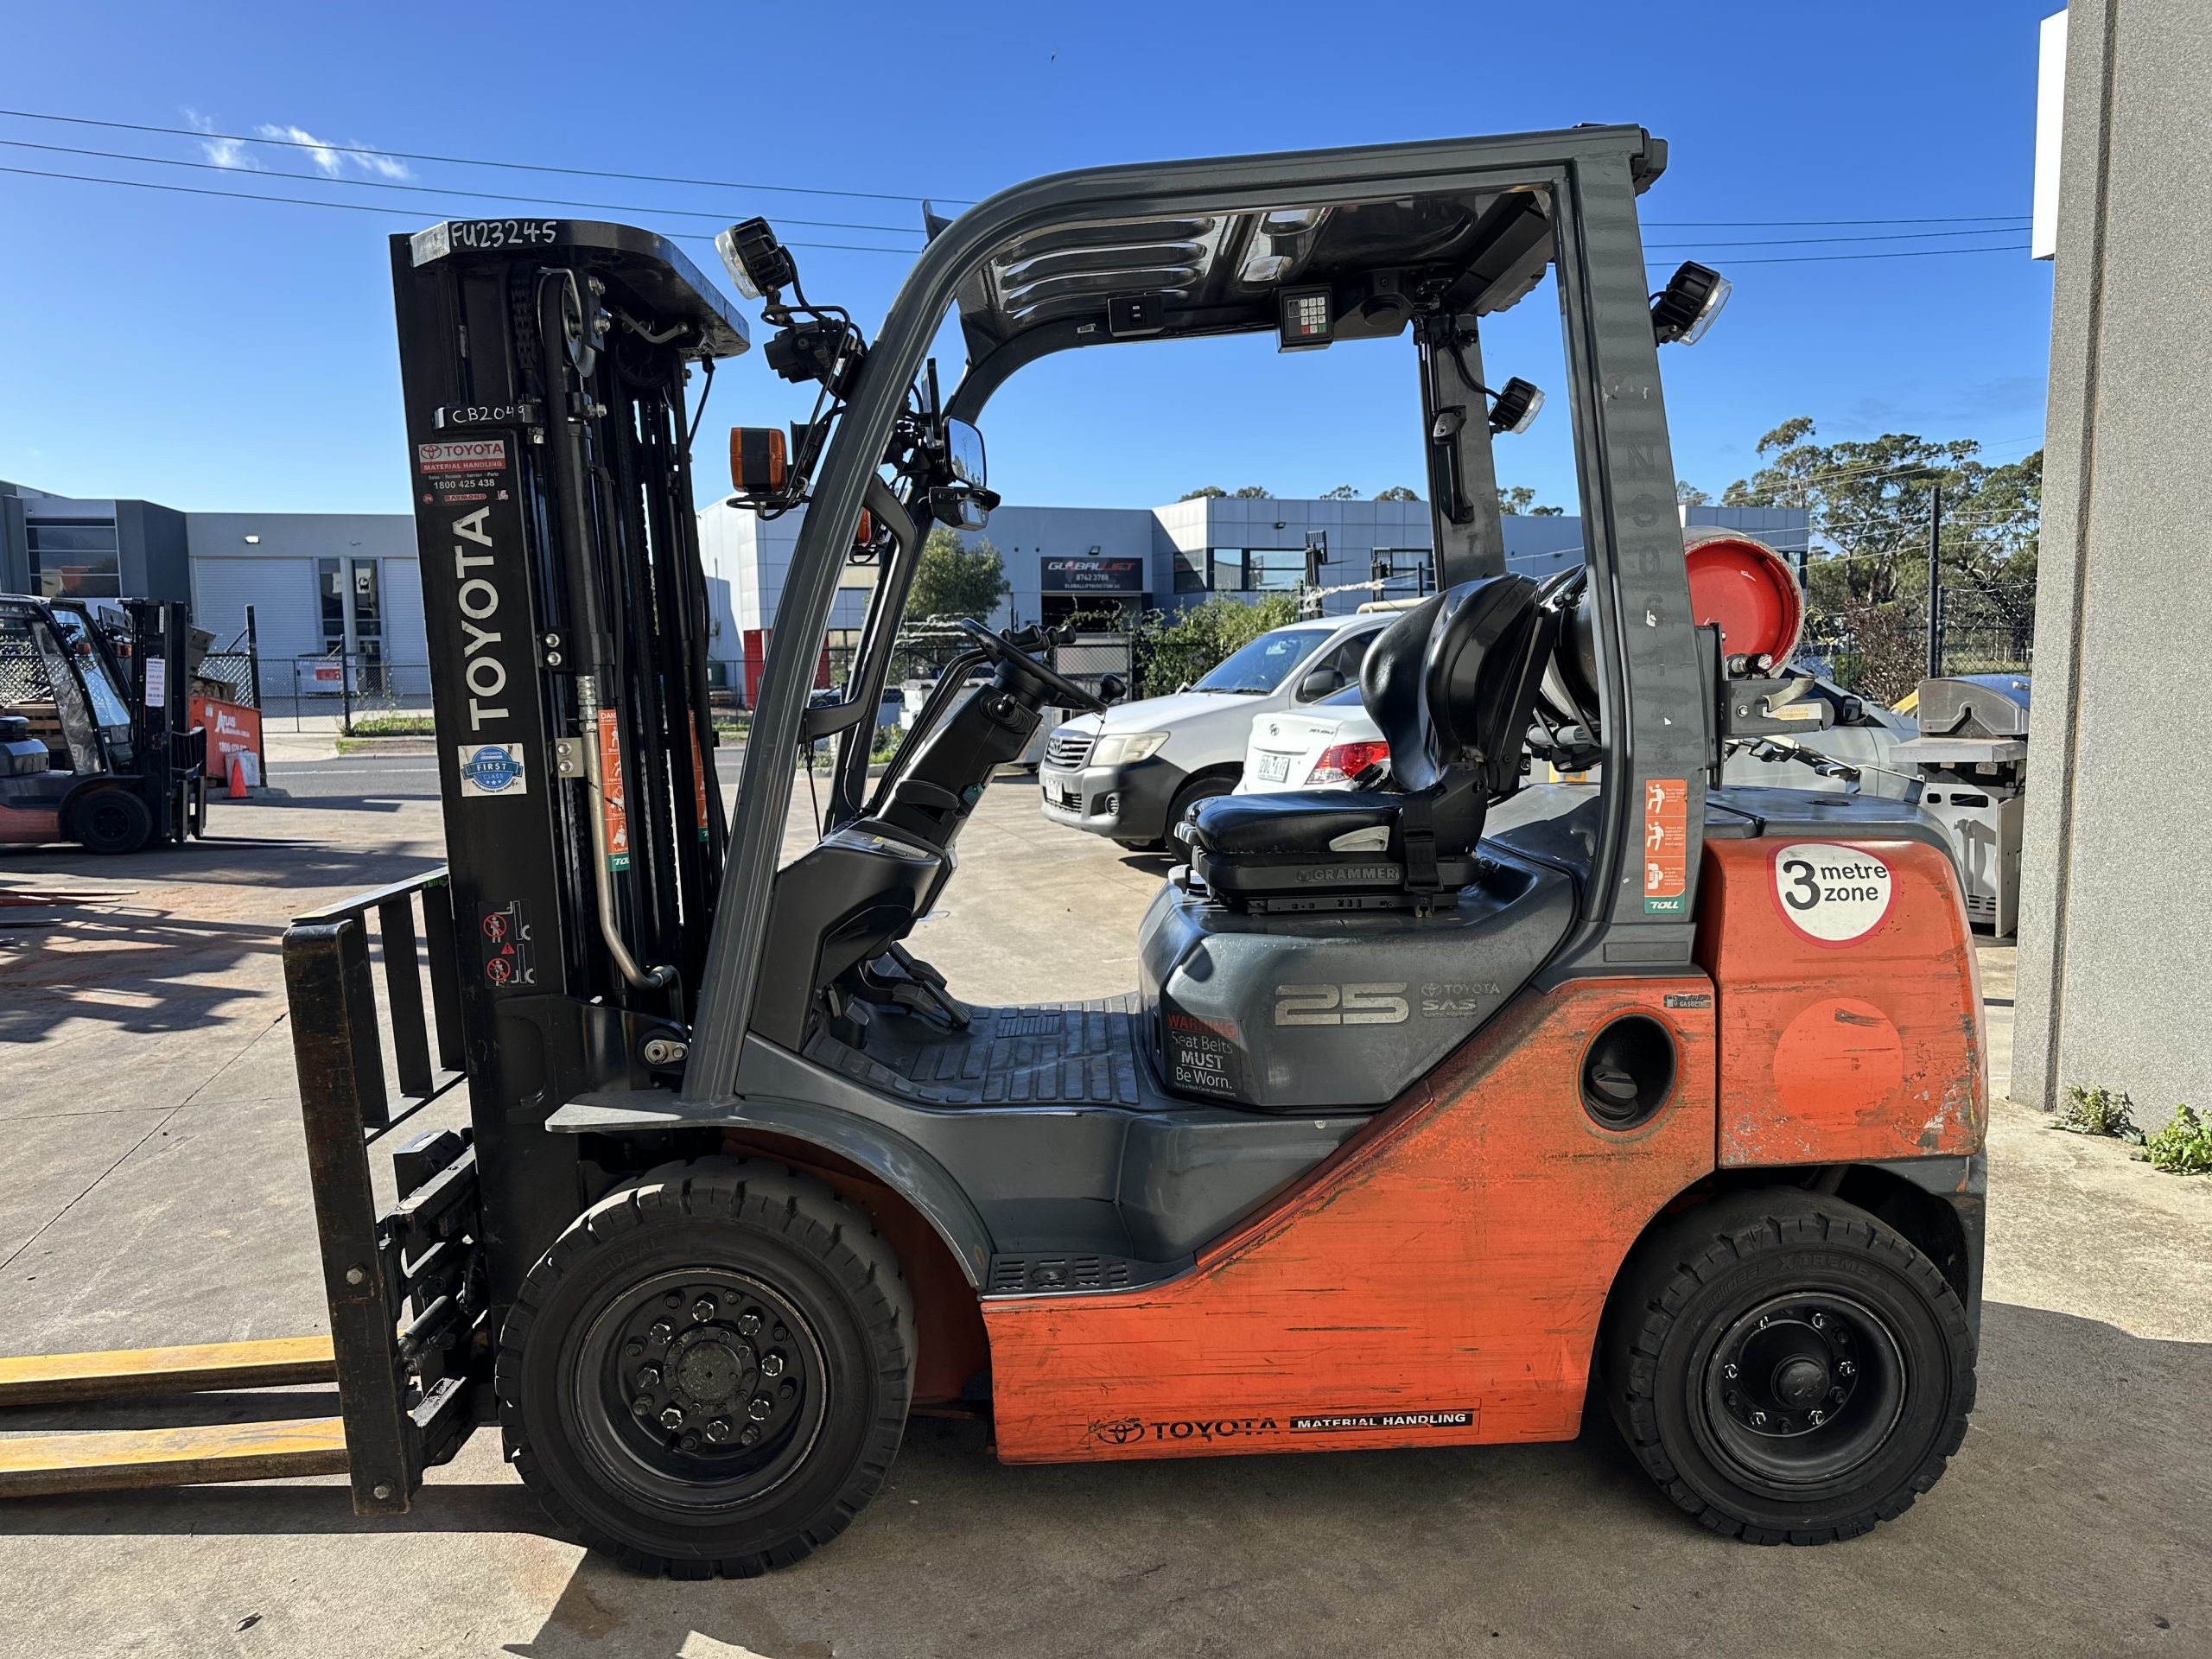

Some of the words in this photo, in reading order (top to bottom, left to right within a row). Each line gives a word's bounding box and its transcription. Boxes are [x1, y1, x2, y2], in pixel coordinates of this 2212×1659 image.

[451, 220, 557, 248] FU23245
[452, 406, 525, 423] CB2049
[444, 442, 504, 457] TOYOTA
[463, 461, 503, 469] HANDLING
[434, 480, 456, 490] 1800
[458, 480, 476, 488] 425
[477, 479, 495, 487] 438
[452, 506, 510, 731] TOYOTA
[476, 763, 507, 772] FIRST
[1314, 867, 1396, 880] GRAMMER
[1783, 860, 1821, 911] 3
[1820, 862, 1888, 880] metre
[1823, 887, 1878, 901] zone
[1649, 900, 1679, 910] TOLL
[1444, 982, 1501, 995] TOYOTA
[1274, 982, 1409, 1026] 25
[1422, 999, 1477, 1011] SAS
[1168, 1014, 1236, 1038] WARNING
[1172, 1031, 1198, 1049] Seat
[1201, 1036, 1233, 1054] Belts
[1181, 1050, 1224, 1069] MUST
[1176, 1066, 1192, 1083] Be
[1193, 1070, 1233, 1090] Worn.
[1297, 1418, 1378, 1428] MATERIAL
[1382, 1413, 1466, 1425] HANDLING
[1150, 1417, 1281, 1442] TOYOTA
